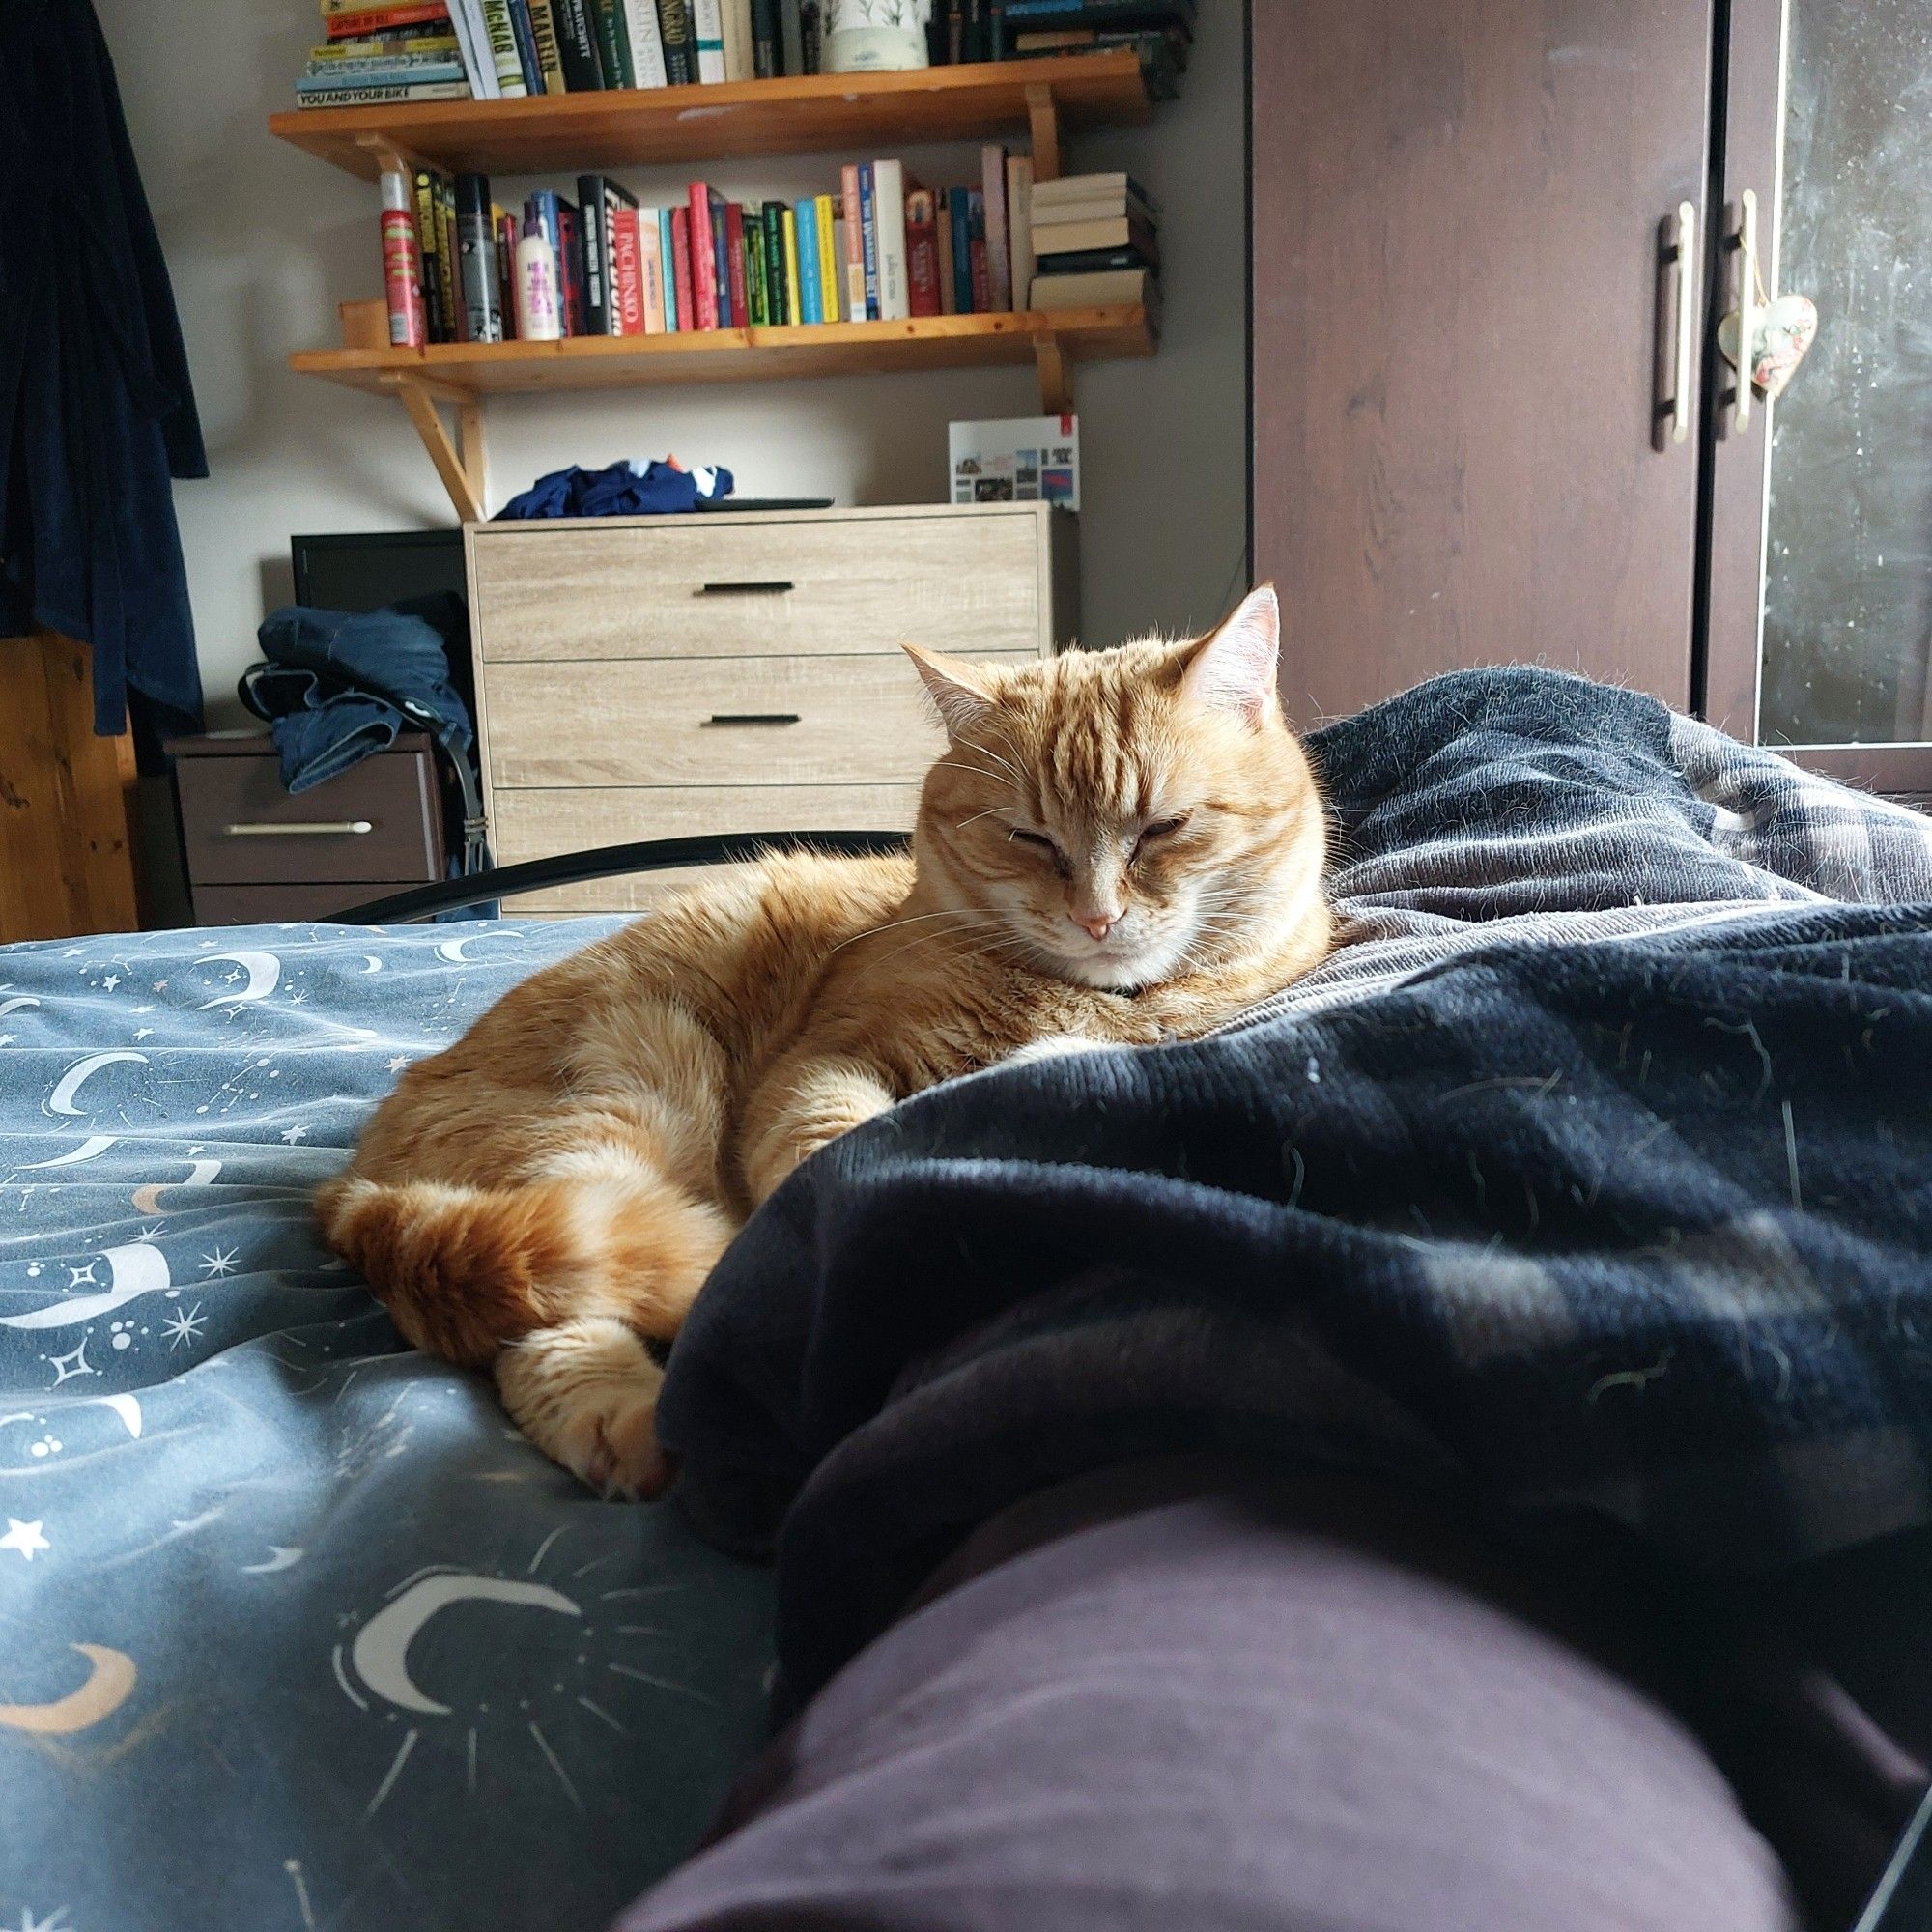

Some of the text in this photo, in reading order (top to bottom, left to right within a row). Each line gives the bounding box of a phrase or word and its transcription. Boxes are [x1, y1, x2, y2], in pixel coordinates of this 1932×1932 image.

[484, 0, 515, 54] McNAB
[530, 5, 558, 71] MARTIN
[300, 87, 410, 104] YOU AND YOUR BIKE
[619, 232, 639, 323] PACHINKO
